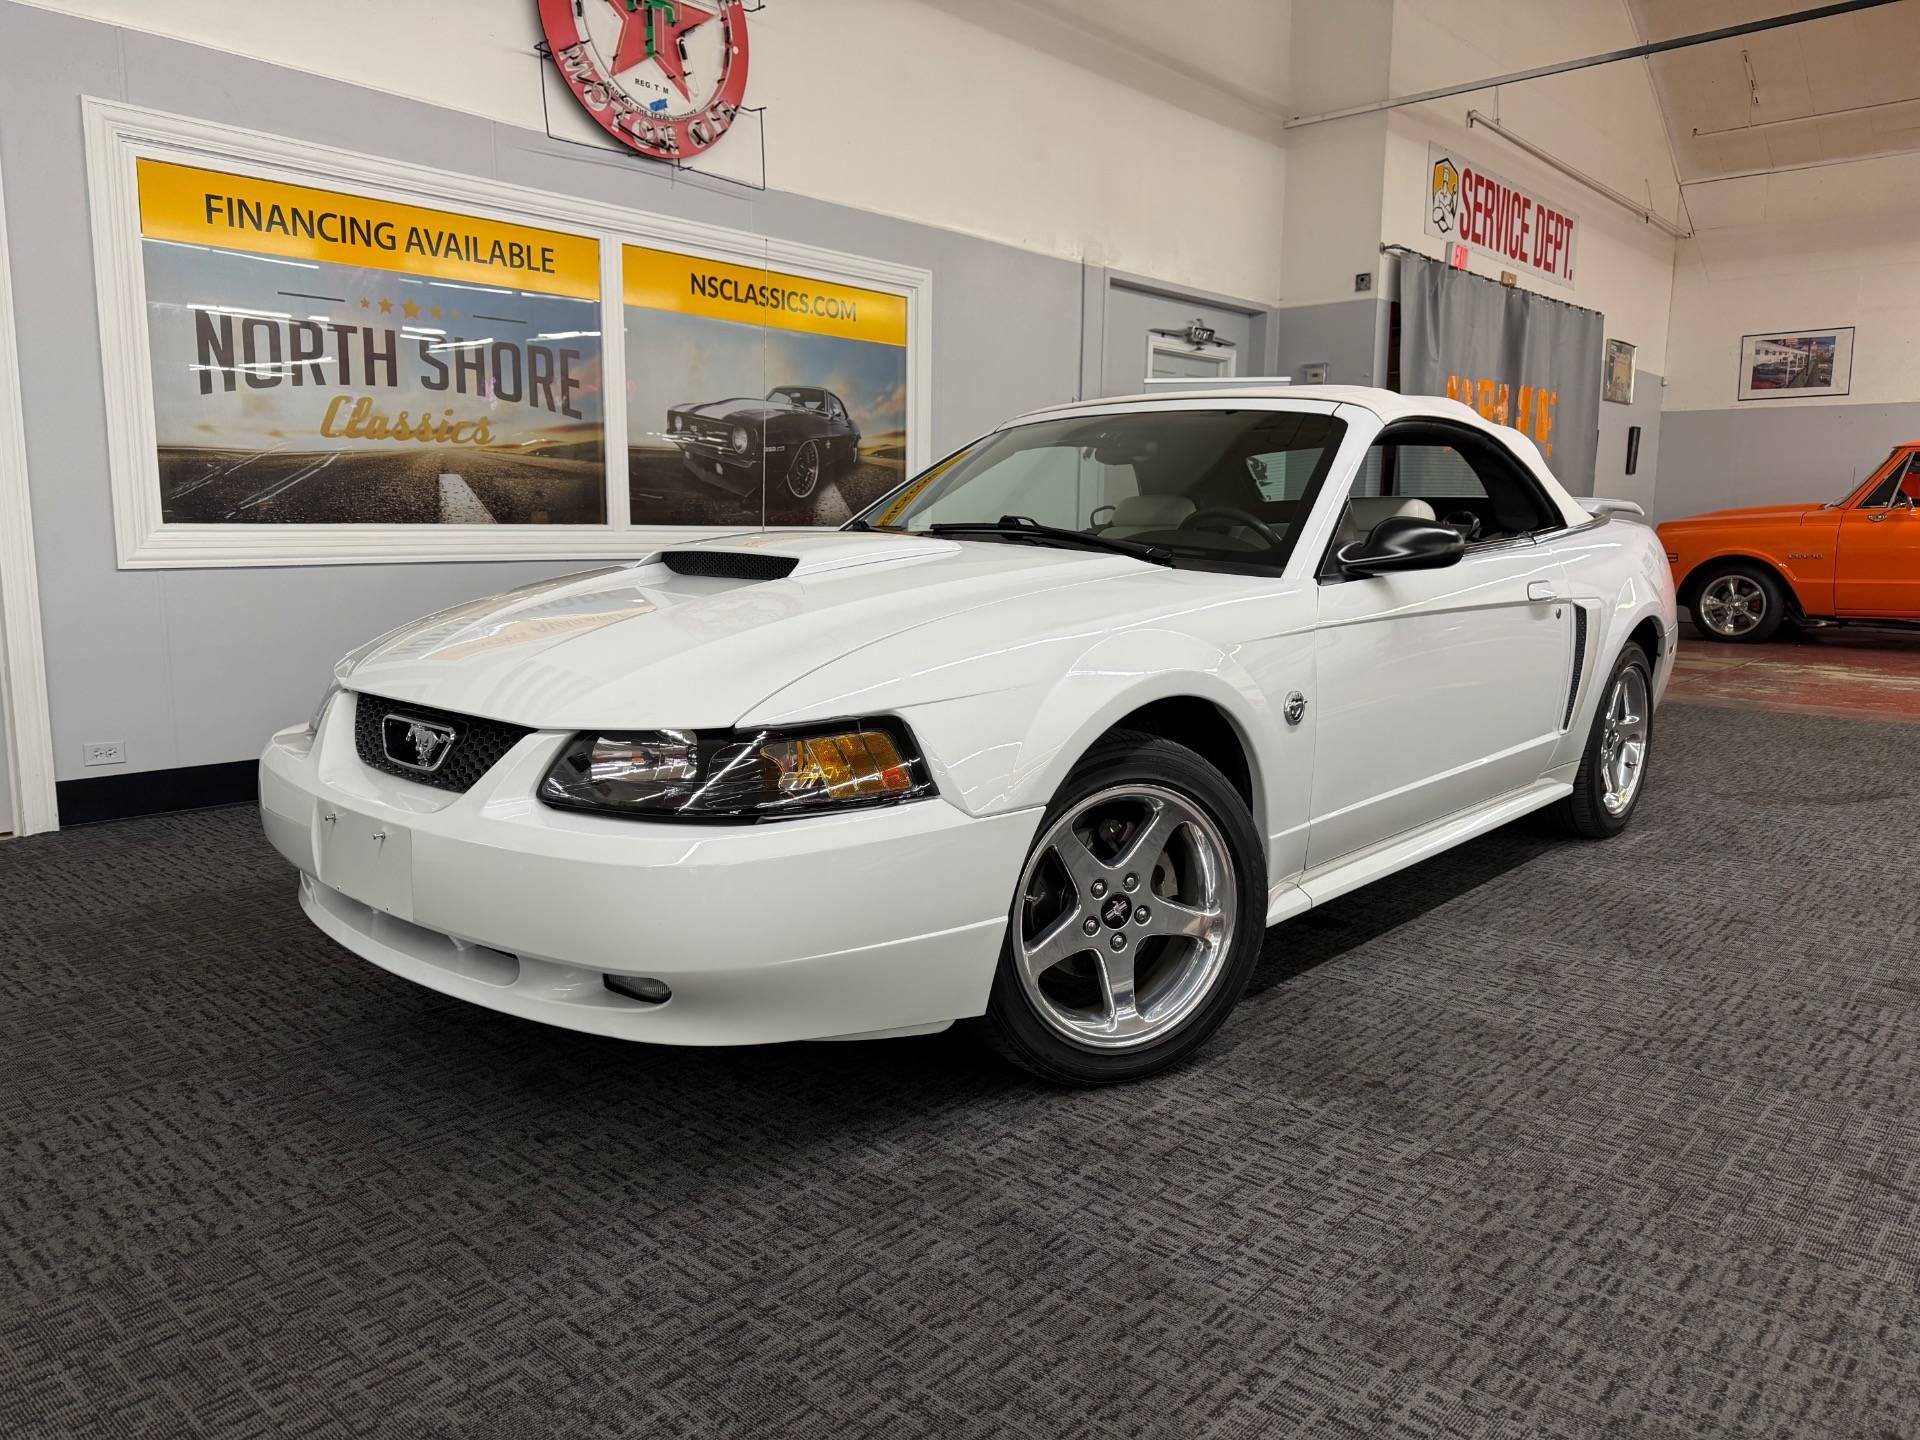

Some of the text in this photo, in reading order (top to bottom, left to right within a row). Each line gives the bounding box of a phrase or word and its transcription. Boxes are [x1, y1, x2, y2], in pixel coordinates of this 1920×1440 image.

[557, 43, 680, 155] MOTOR
[634, 105, 648, 117] THE
[204, 193, 556, 274] FINANCING AVAILABLE
[1459, 168, 1574, 281] SERVICE DEPT.
[690, 272, 857, 322] NSCLASSICS.COM
[194, 307, 583, 421] NORTH SHORE
[319, 394, 497, 446] Classics
